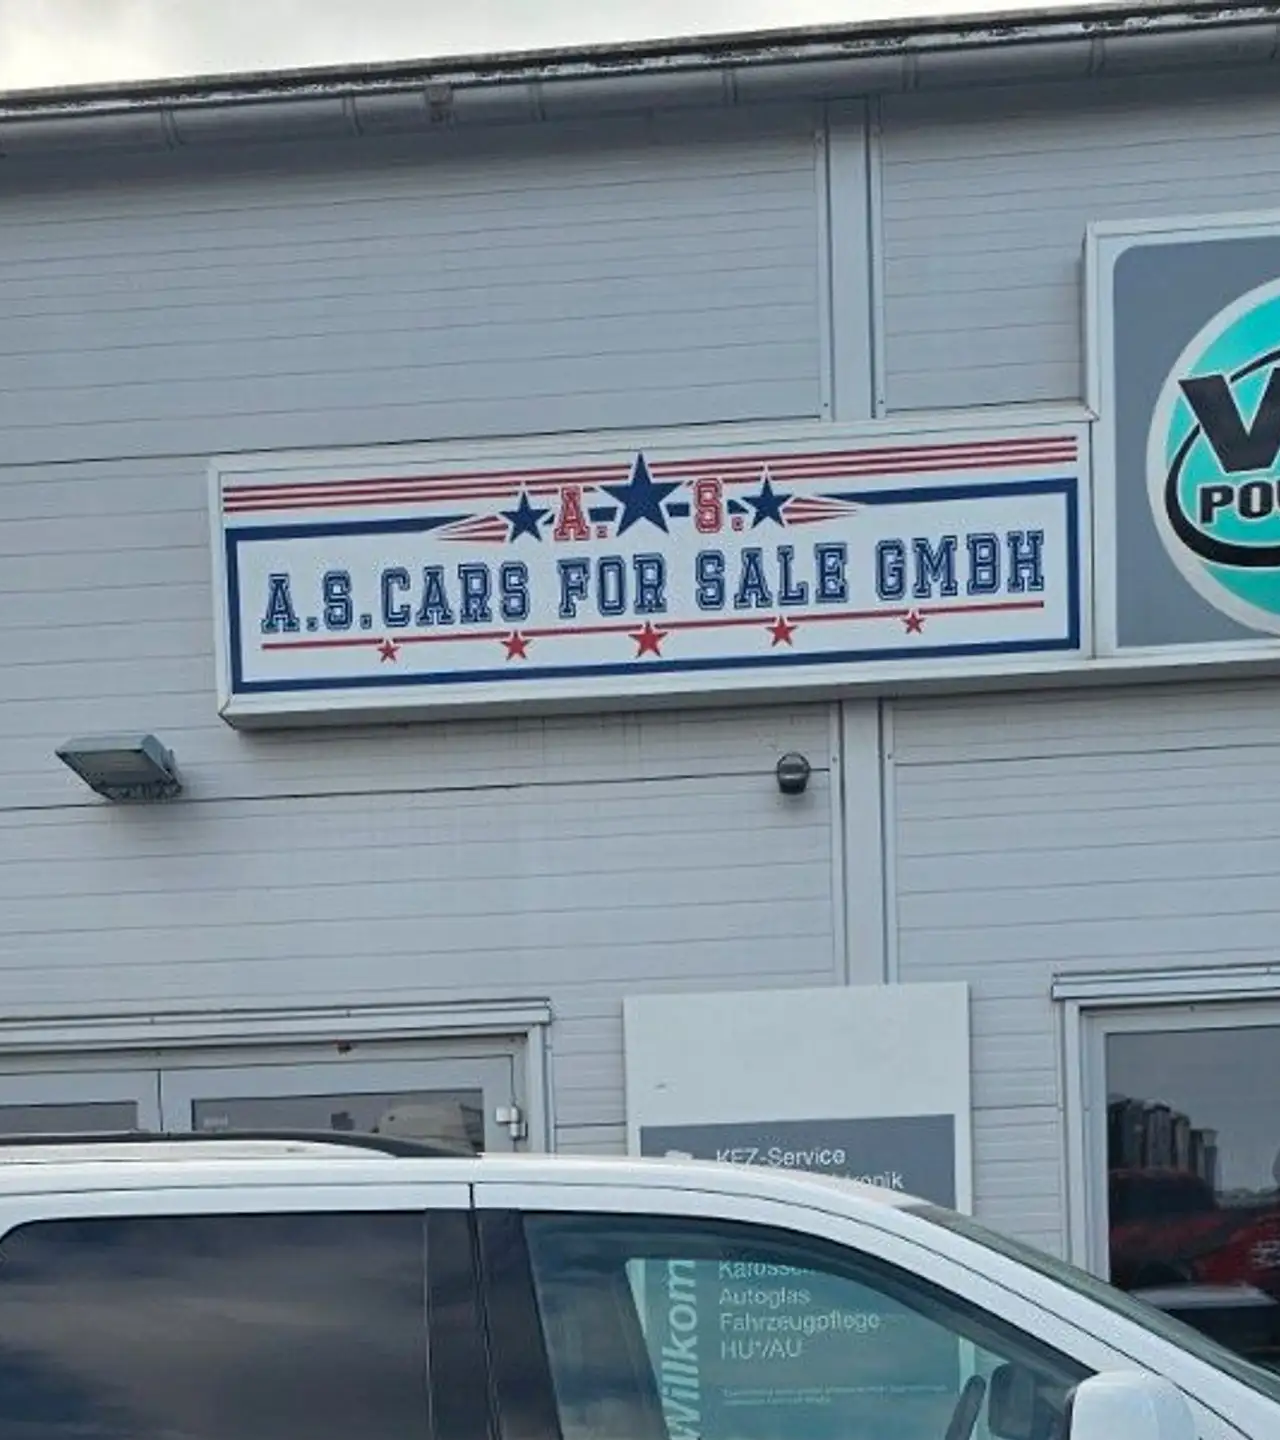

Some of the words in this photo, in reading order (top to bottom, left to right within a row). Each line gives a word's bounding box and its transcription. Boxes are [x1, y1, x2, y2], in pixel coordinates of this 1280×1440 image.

[261, 560, 530, 634] A.S.CARS
[557, 552, 668, 619] FOR
[694, 542, 849, 611] SALE
[875, 529, 1045, 600] GMBH
[719, 1286, 812, 1309] Autoglas
[720, 1310, 880, 1336] Fahrzeugpflege
